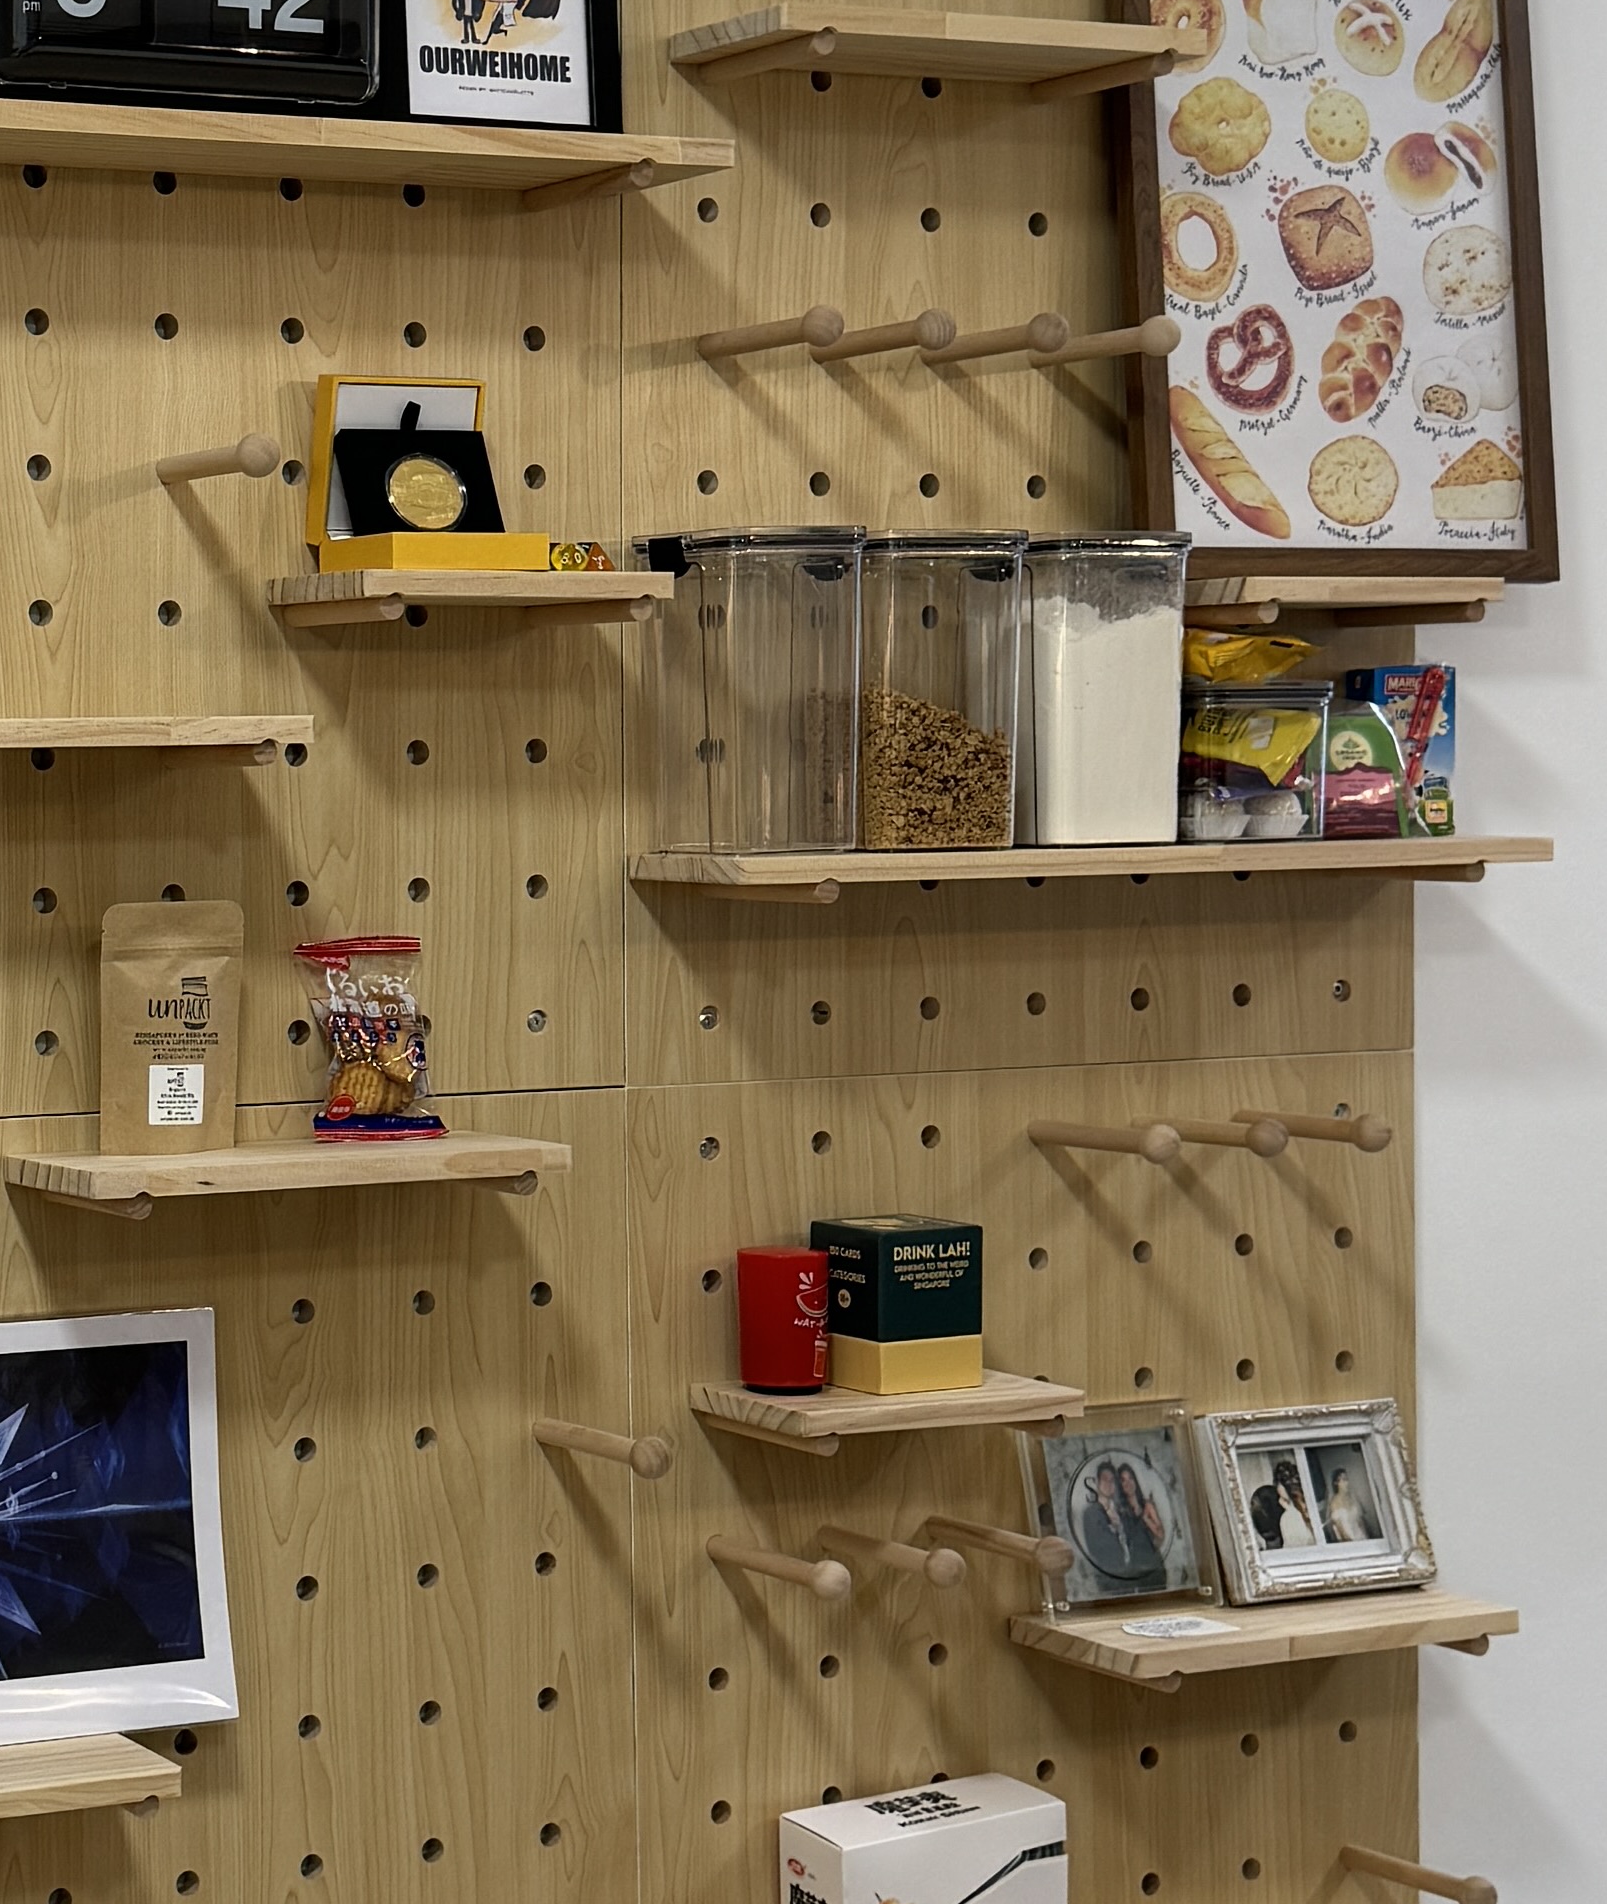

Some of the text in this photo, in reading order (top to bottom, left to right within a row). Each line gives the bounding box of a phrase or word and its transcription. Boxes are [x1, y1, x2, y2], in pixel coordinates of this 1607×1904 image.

[419, 44, 571, 83] OURWEIHOME
[894, 1241, 971, 1261] DRINK LAH!
[926, 1262, 936, 1271] TO
